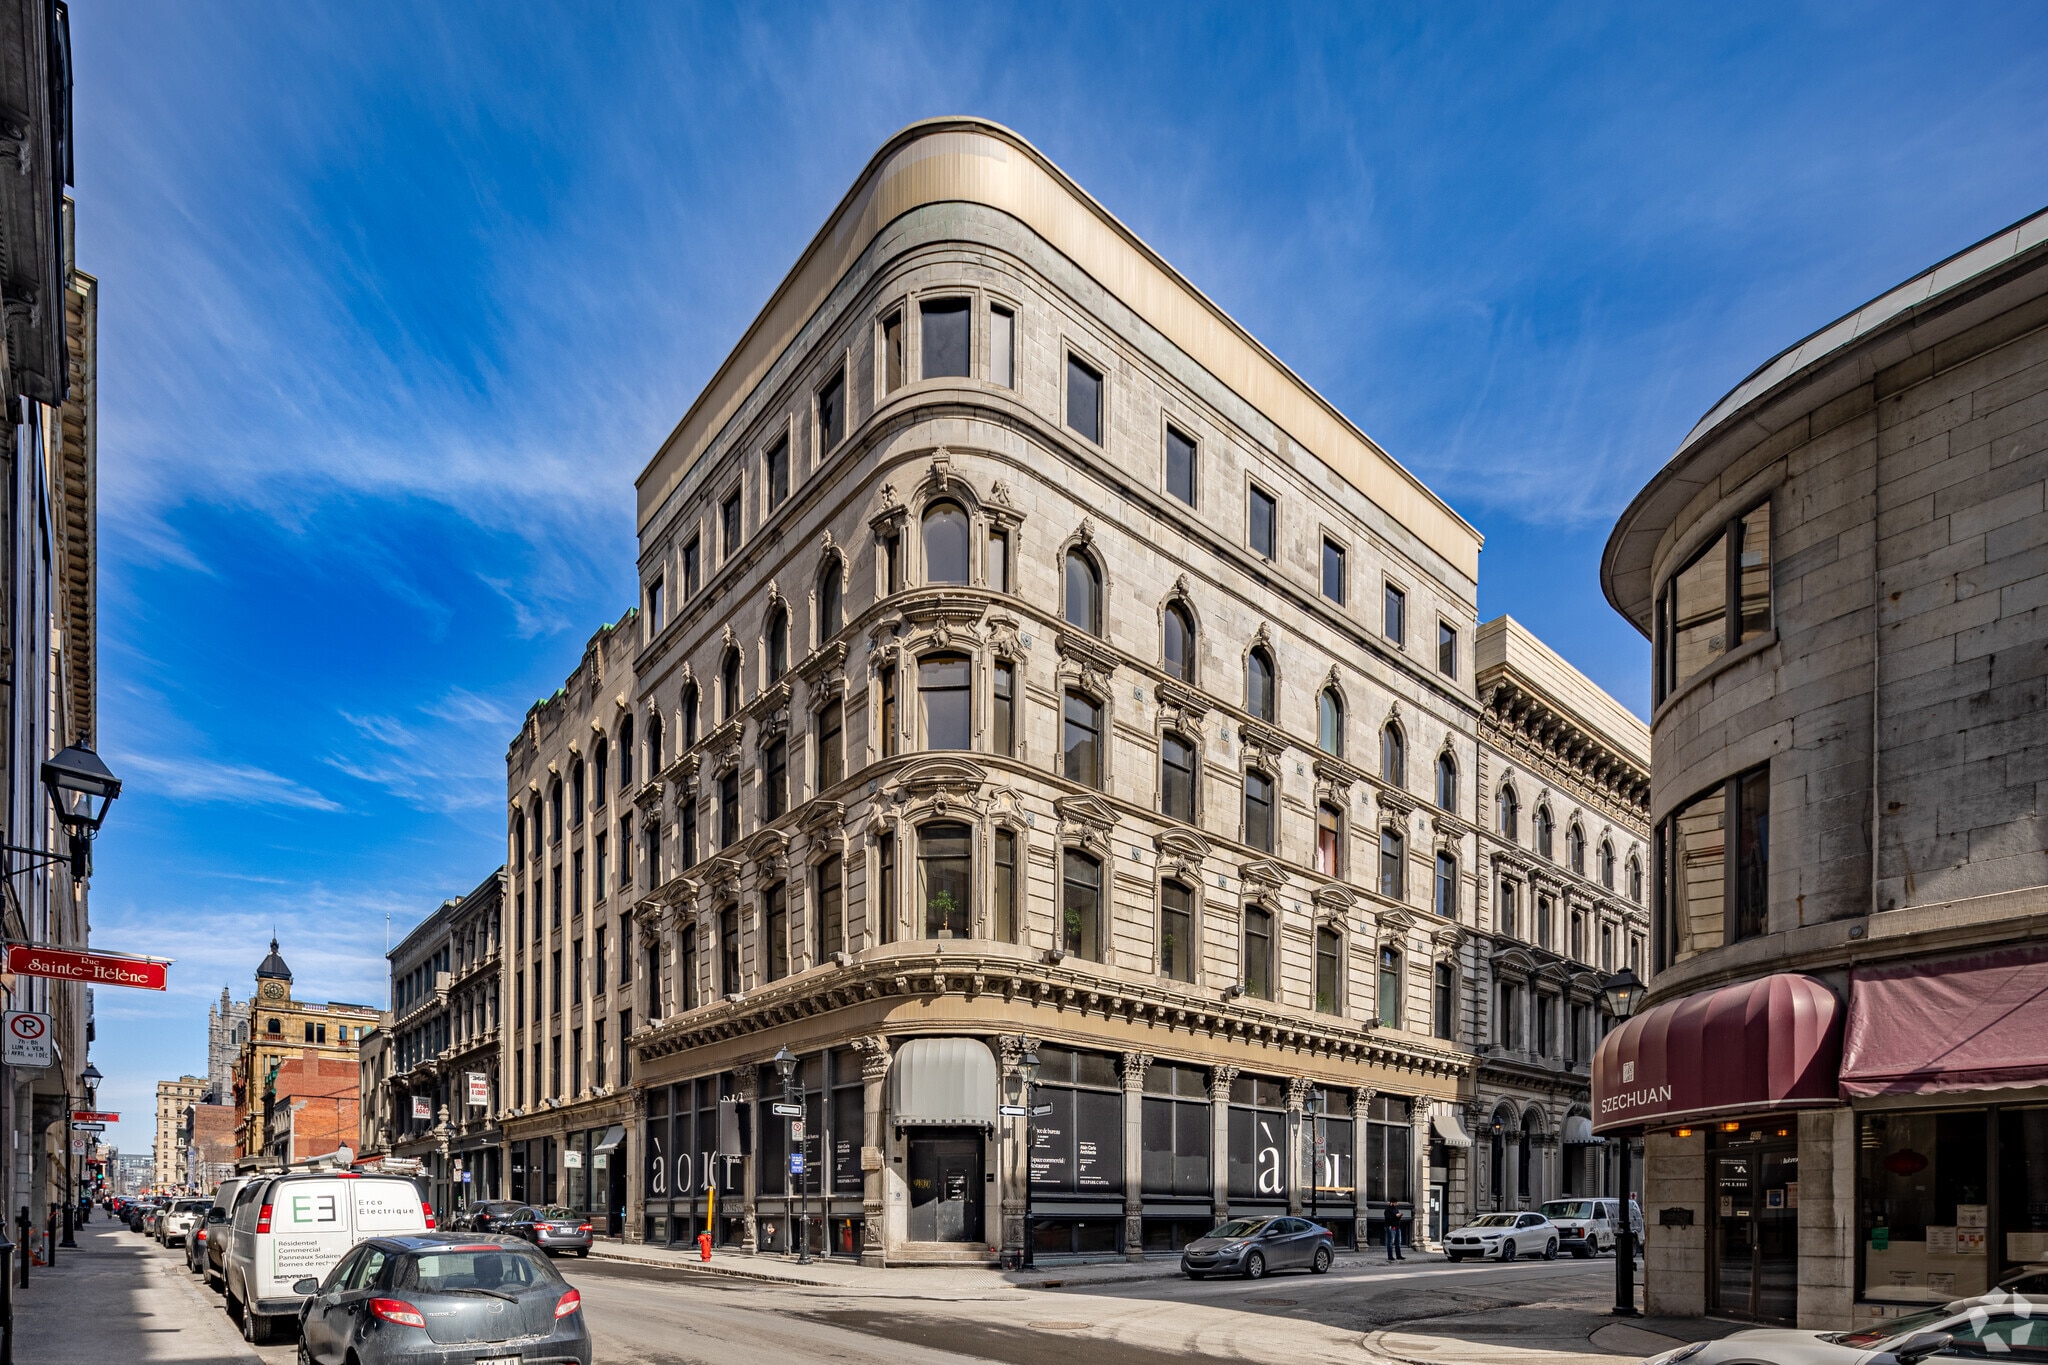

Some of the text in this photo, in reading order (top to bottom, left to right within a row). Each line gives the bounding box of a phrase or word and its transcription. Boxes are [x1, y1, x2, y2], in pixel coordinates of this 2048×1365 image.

[28, 958, 149, 984] Sainte-Hélène
[81, 957, 100, 966] Rue
[1601, 1084, 1672, 1114] SZECHUAN
[652, 1137, 667, 1193] à
[1258, 1121, 1284, 1195] à
